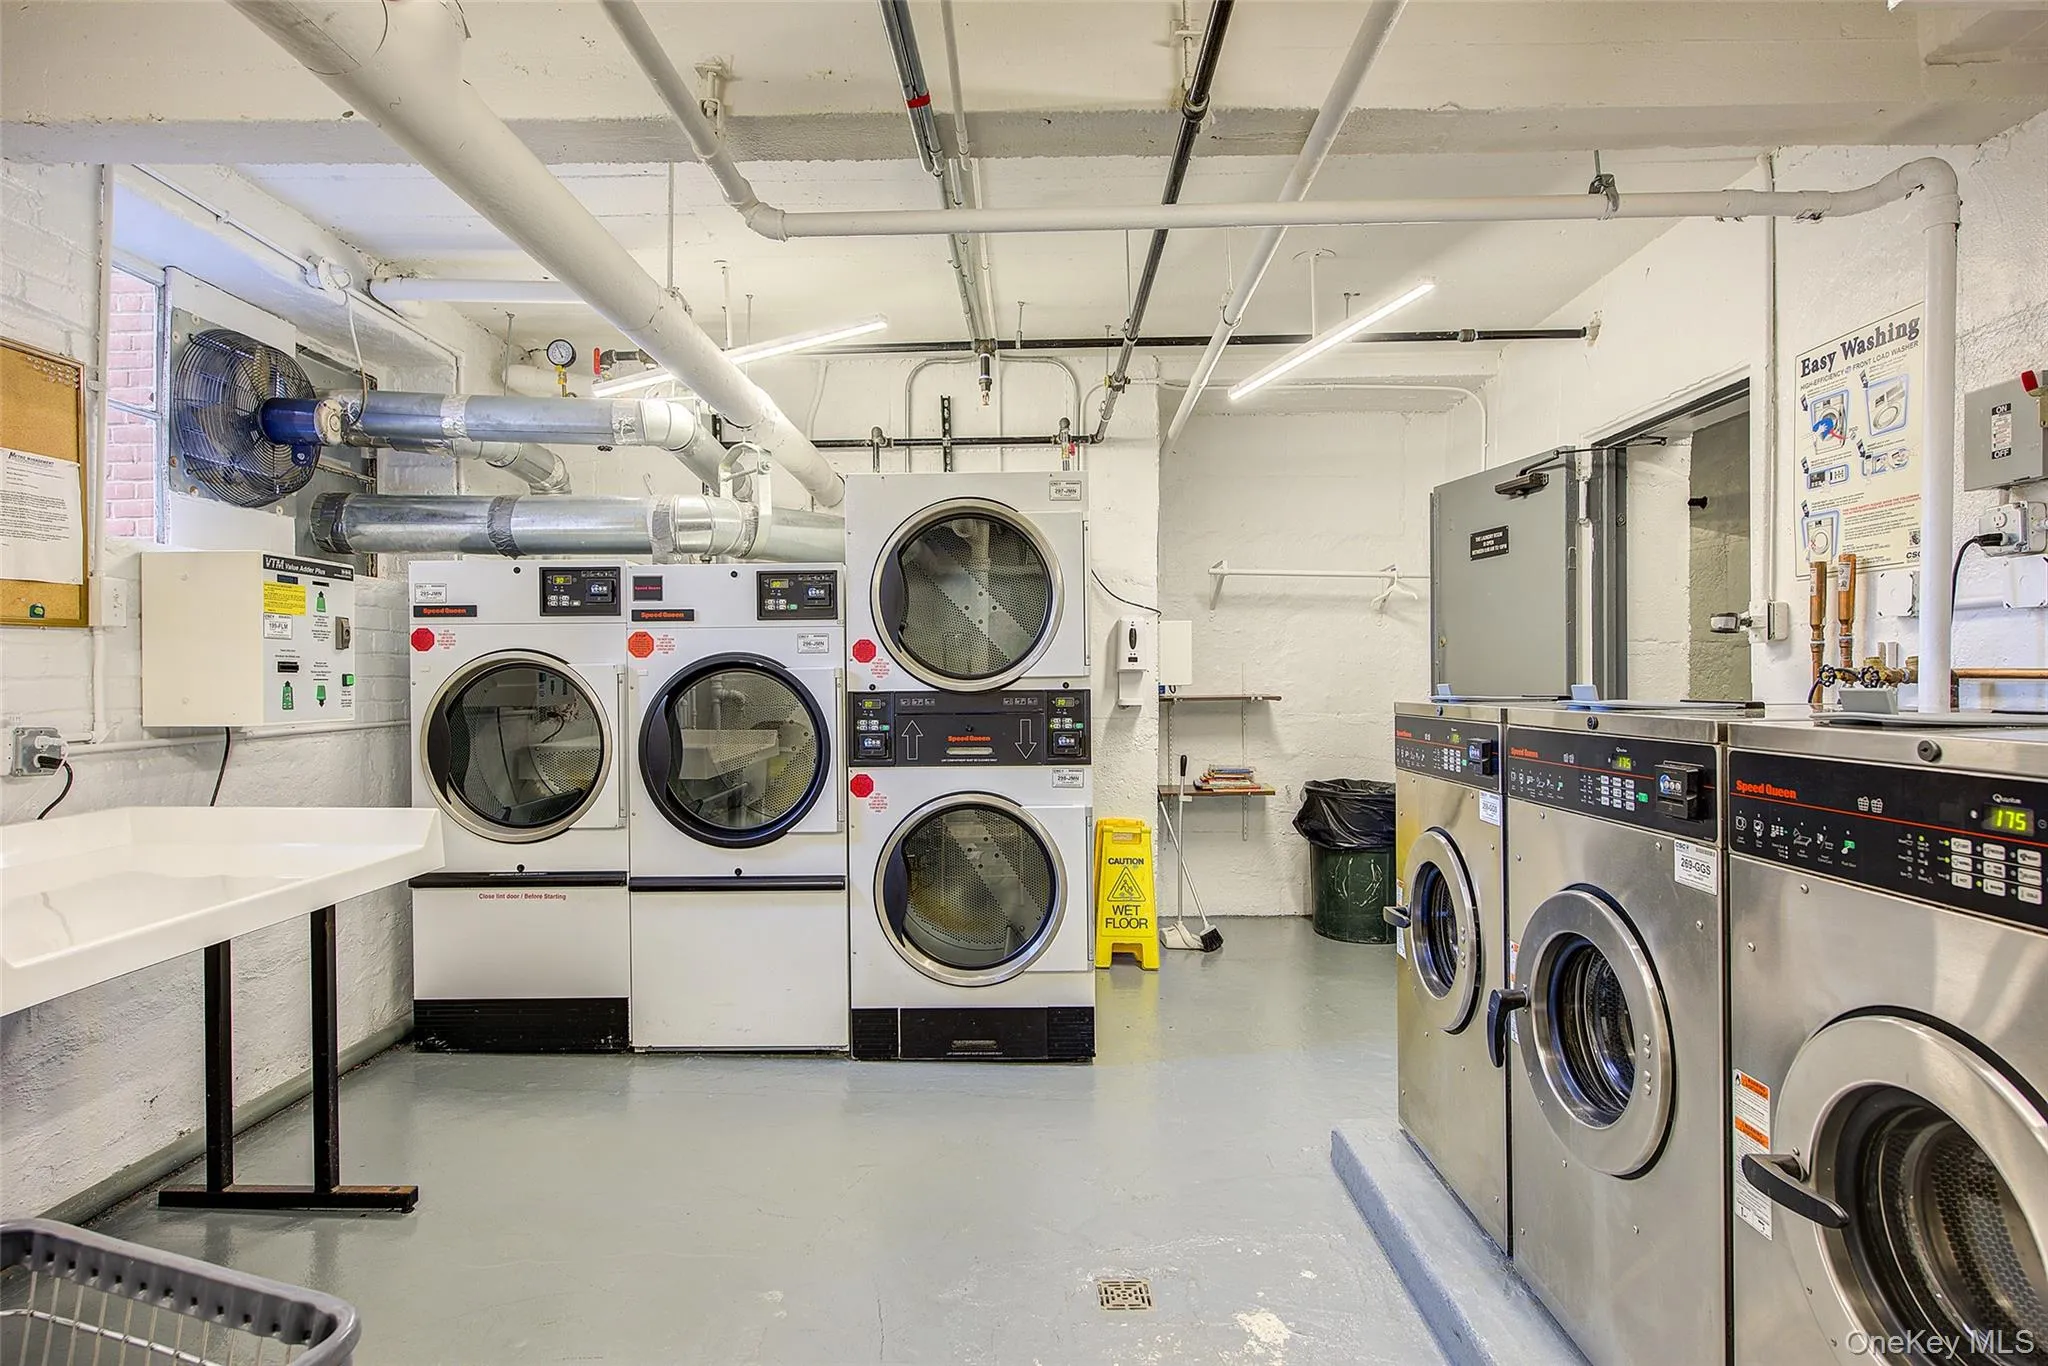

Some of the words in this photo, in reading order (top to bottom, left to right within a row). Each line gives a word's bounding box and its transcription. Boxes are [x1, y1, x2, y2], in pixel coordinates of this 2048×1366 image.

[1800, 351, 1837, 378] Easy
[1840, 317, 1920, 361] Washing
[1891, 340, 1920, 356] WASHER
[1996, 403, 2008, 414] ON
[1994, 449, 2010, 459] OFF
[264, 557, 284, 570] VTM
[300, 565, 314, 573] Adder
[1735, 780, 1764, 794] Speed
[1766, 784, 1797, 799] Queen
[1995, 809, 2026, 831] 175
[1680, 857, 1712, 875] 269-GGS
[543, 893, 567, 901] Starting
[1112, 905, 1141, 916] WET
[1105, 918, 1148, 929] FLOOR
